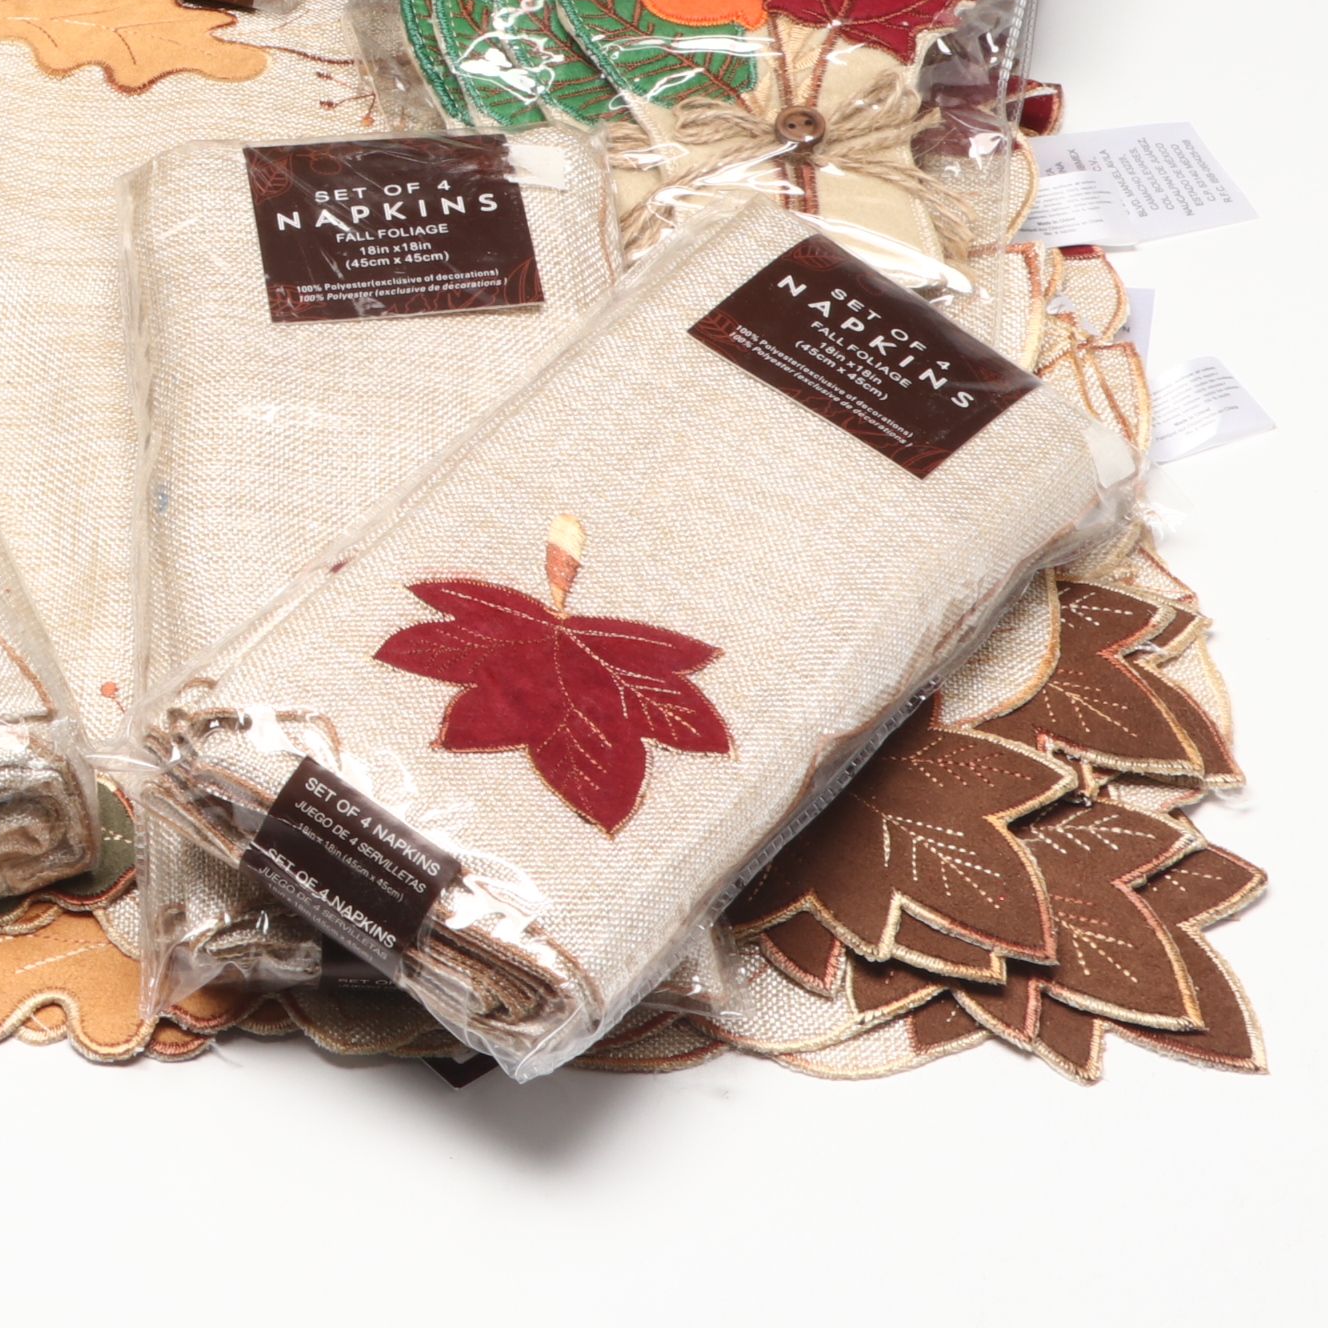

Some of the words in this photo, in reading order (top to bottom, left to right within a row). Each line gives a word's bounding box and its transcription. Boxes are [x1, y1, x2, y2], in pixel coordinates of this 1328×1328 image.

[314, 186, 368, 203] SET
[383, 182, 421, 197] OF
[437, 179, 452, 191] 4
[276, 193, 499, 231] NAPKINS
[335, 231, 374, 244] FALL
[377, 223, 449, 240] FOLIAGE
[359, 243, 390, 255] 18in
[345, 256, 390, 271] (45cm
[393, 256, 402, 265] x
[404, 251, 450, 264] 45cm)
[296, 283, 322, 294] 100%
[298, 292, 324, 303] 100%
[326, 288, 373, 302] Polyester
[425, 283, 439, 292] de
[735, 324, 760, 342] 100%
[777, 274, 975, 409] NAPKINS
[830, 287, 882, 322] SET
[890, 327, 928, 353] OF
[936, 359, 951, 371] 4
[810, 320, 847, 348] FALL
[846, 344, 913, 389] FOLIAGE
[819, 341, 846, 363] 18in
[728, 332, 754, 349] 100%
[751, 345, 795, 374] Polyester
[840, 401, 853, 410] de
[794, 339, 837, 369] (45cm
[836, 366, 846, 374] x
[847, 373, 888, 401] 45cm)
[304, 777, 337, 803] SET
[336, 799, 360, 818] OF
[360, 816, 372, 828] 4
[372, 823, 441, 877] NAPKINS
[294, 800, 333, 828] JUEGO
[332, 824, 351, 840] DE
[349, 837, 359, 846] 4
[357, 842, 427, 894] SERVILLETAS
[259, 866, 296, 893] JUEGO
[331, 895, 397, 949] NAPKINS
